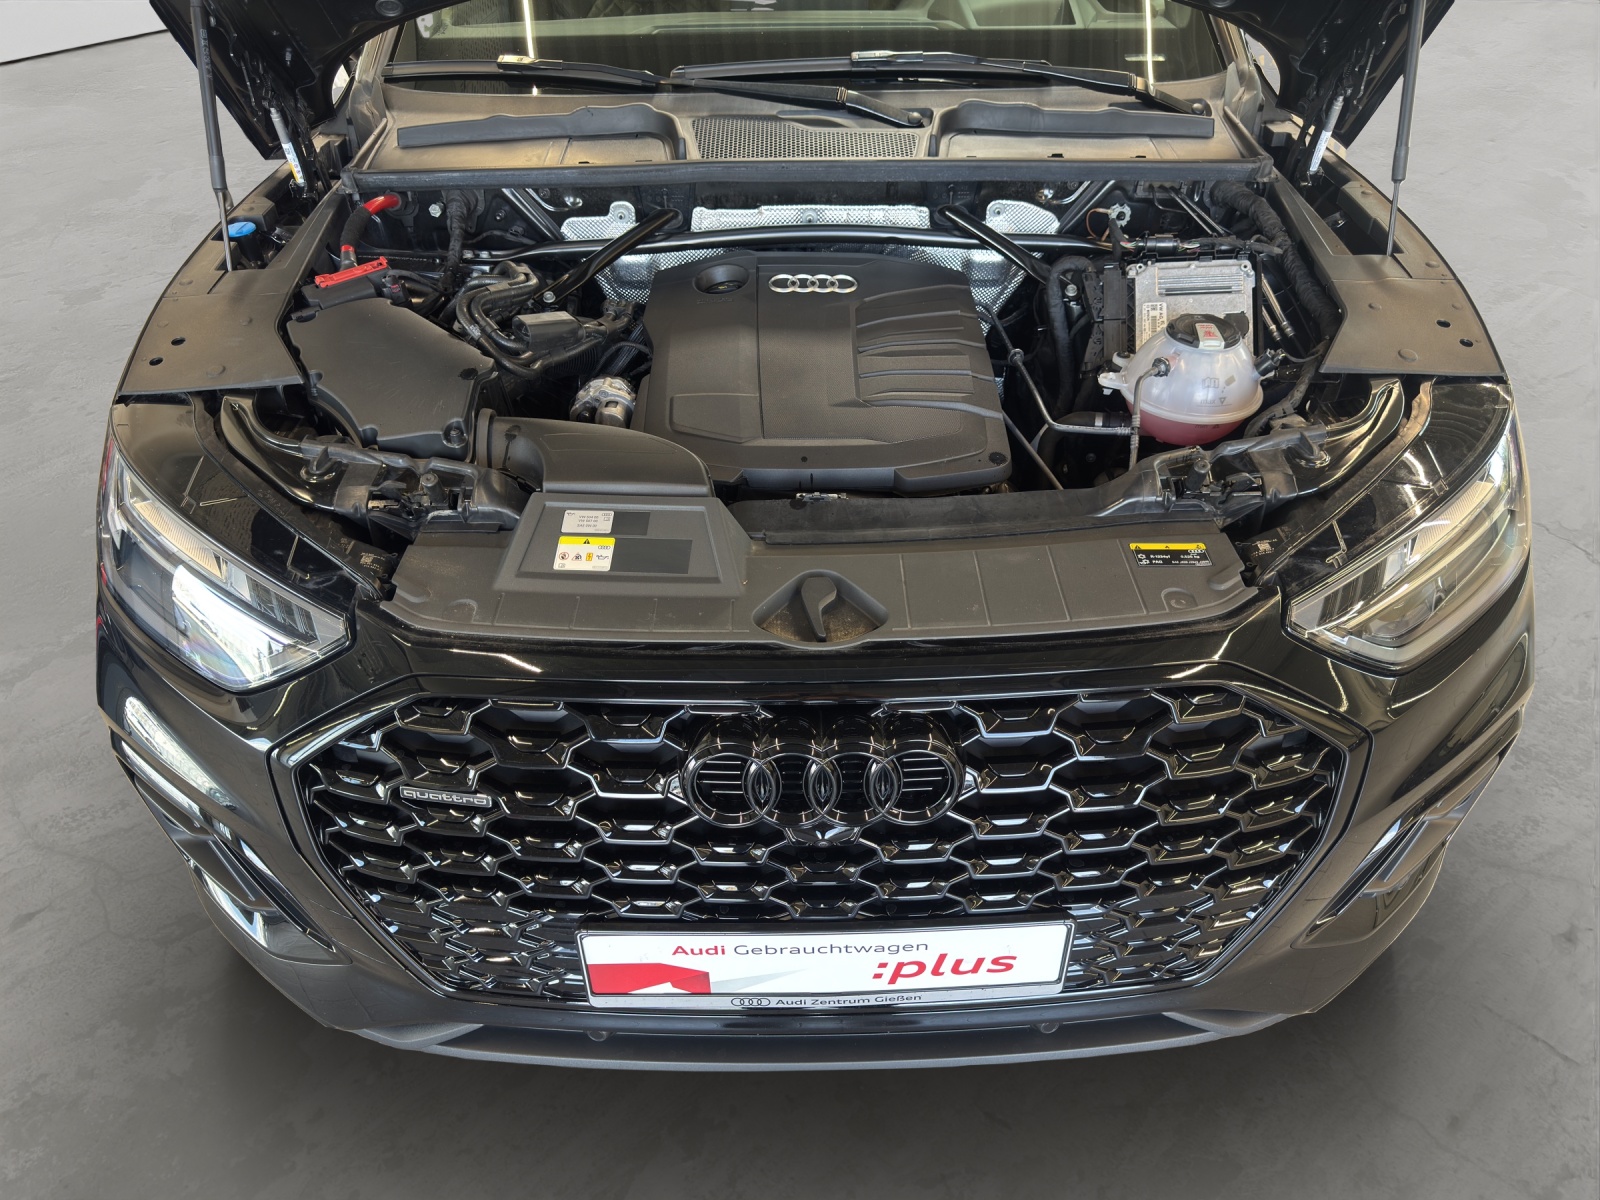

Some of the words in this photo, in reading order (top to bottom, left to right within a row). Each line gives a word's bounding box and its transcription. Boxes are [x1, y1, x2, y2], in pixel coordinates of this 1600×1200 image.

[403, 789, 487, 805] quattro
[672, 945, 726, 956] Audi
[734, 942, 928, 956] Gebrauchtwagen
[811, 997, 870, 1006] Zentrum
[874, 995, 922, 1003] Gießen
